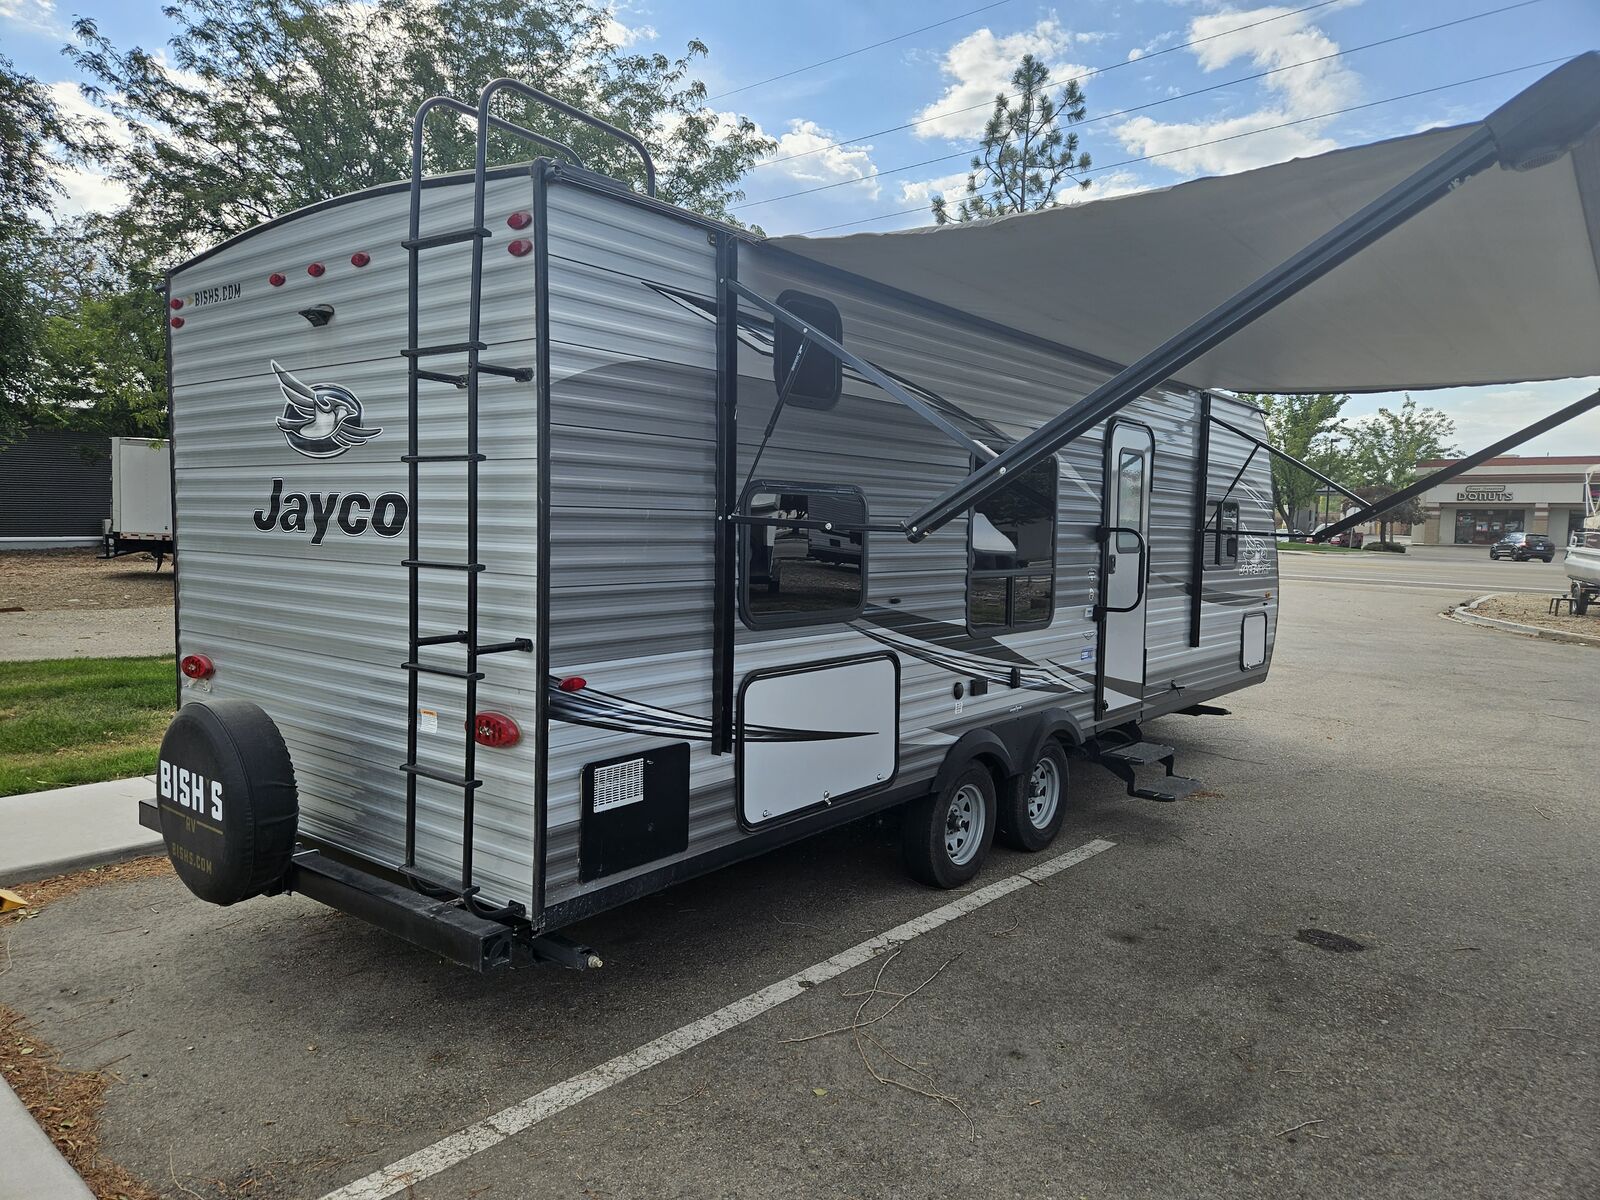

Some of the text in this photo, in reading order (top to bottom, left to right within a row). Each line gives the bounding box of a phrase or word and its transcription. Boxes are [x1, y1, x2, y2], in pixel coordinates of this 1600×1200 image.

[194, 283, 241, 307] BISHS.COM
[252, 477, 409, 546] Jayco
[185, 816, 196, 833] RV
[171, 842, 213, 876] BISHS.COM
